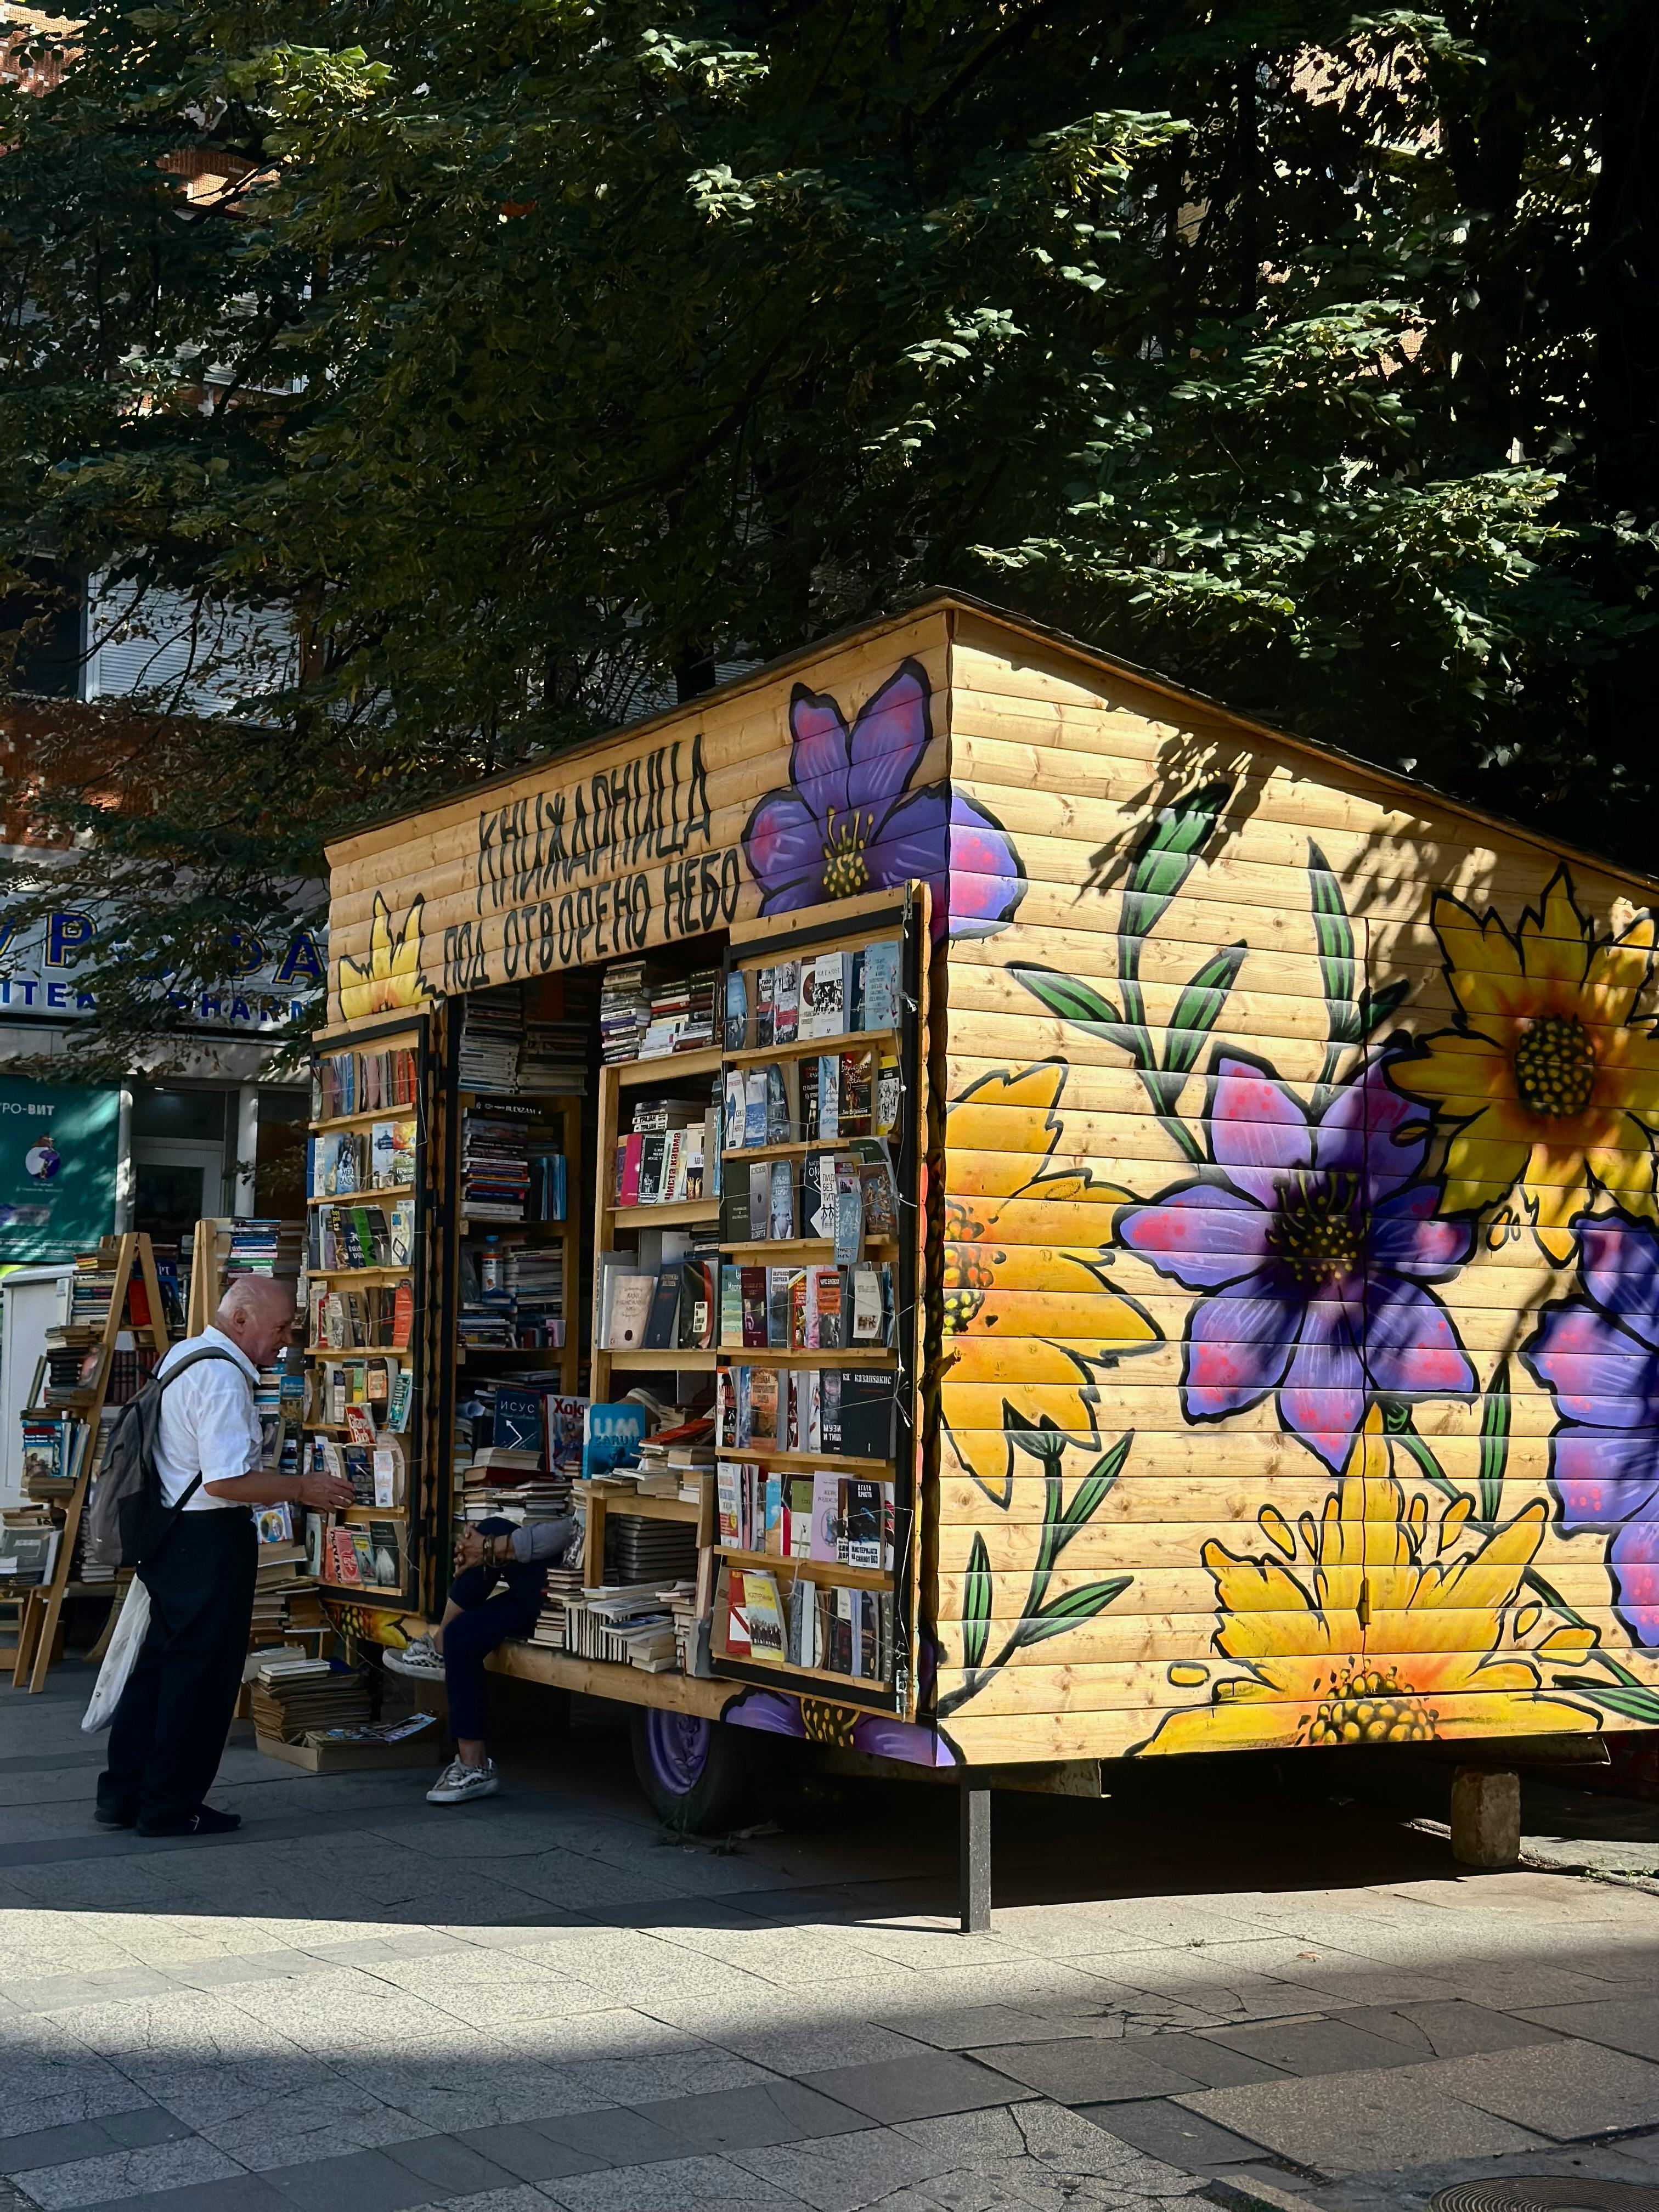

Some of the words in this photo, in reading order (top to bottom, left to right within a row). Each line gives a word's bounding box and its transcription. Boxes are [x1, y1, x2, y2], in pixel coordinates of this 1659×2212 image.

[477, 733, 711, 916] КНИЖАРНИЦА
[444, 921, 490, 991] ПОД
[503, 872, 652, 979] ОТВОРЕНО
[664, 848, 741, 940] НЕБО
[822, 1193, 834, 1201] ТИТ
[500, 1400, 535, 1413] ИСУС
[823, 1424, 841, 1432] МУЗИ
